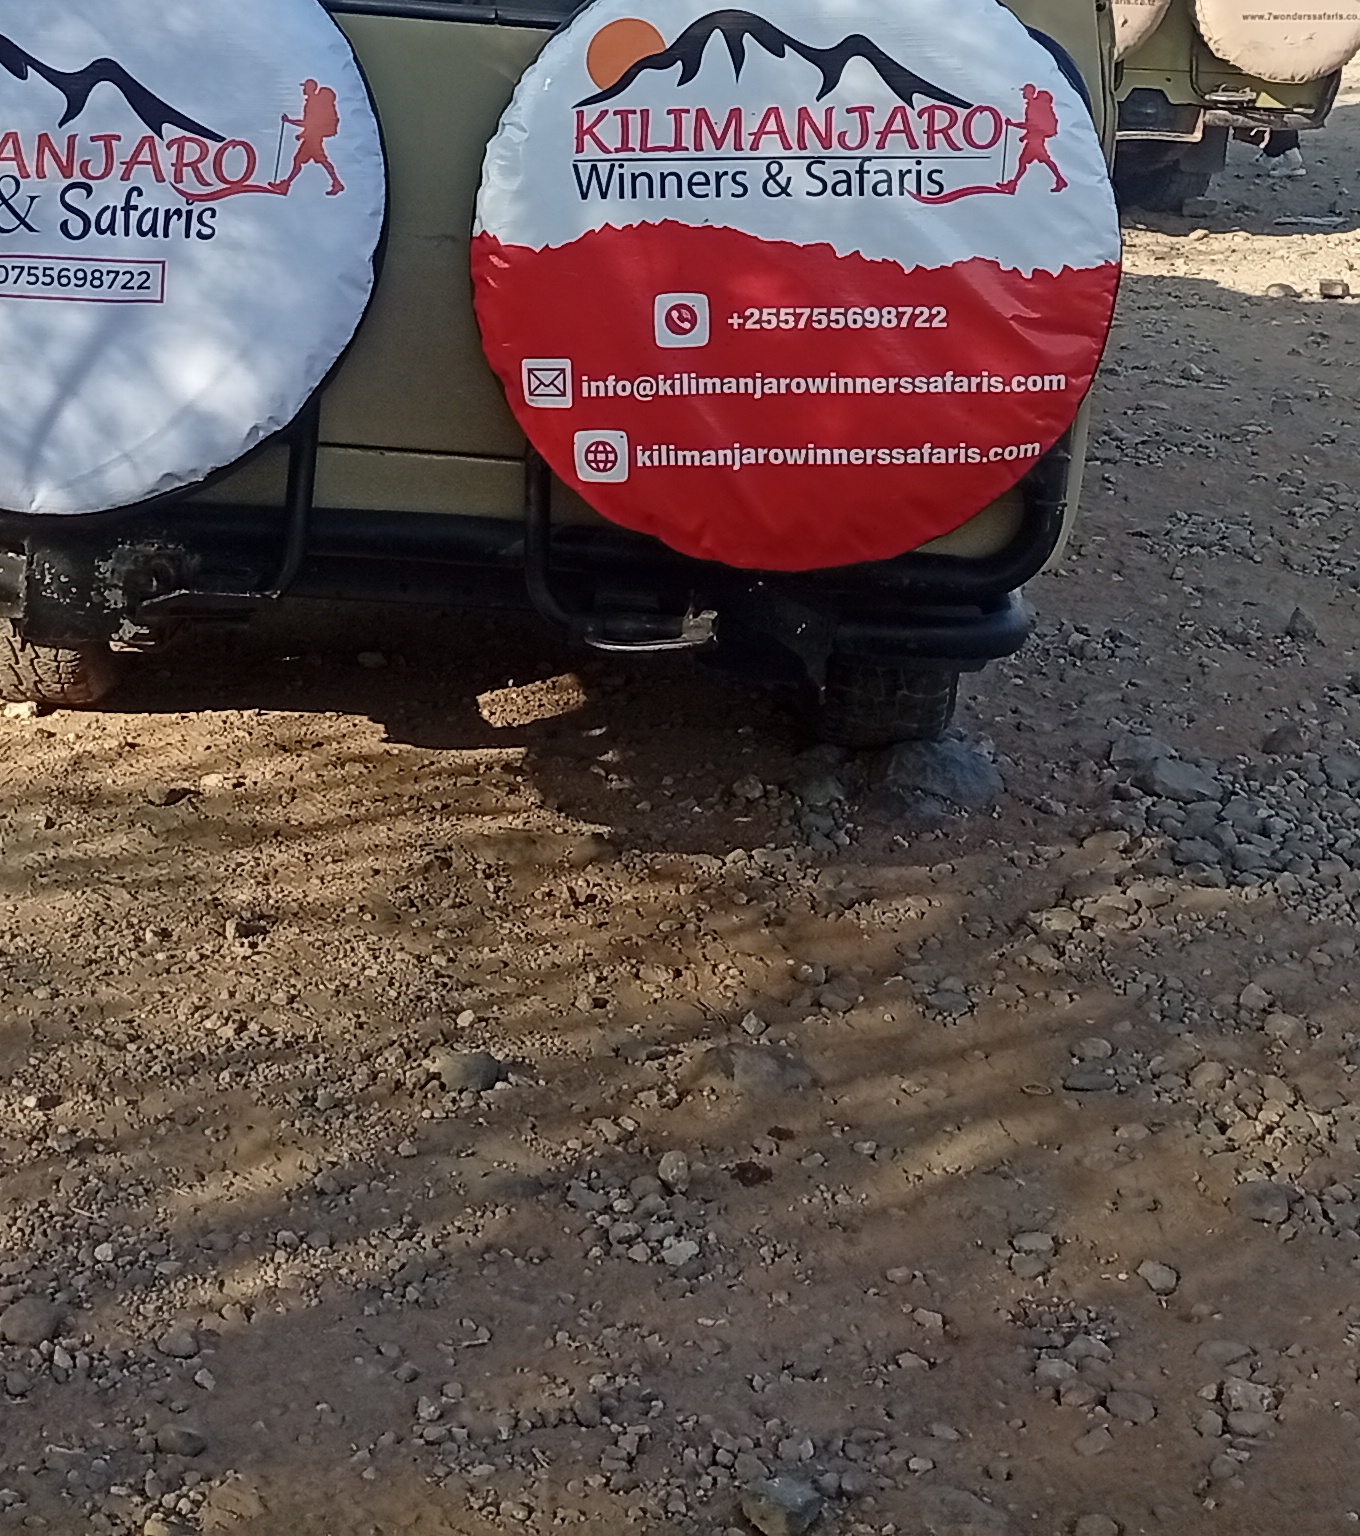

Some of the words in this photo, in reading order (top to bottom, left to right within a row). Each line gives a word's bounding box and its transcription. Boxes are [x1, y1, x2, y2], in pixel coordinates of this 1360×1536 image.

[573, 104, 1004, 154] KILIMANJARO
[572, 163, 749, 200] Winners
[761, 160, 794, 198] &
[805, 159, 945, 198] Safaris
[58, 181, 218, 243] Safaris
[727, 306, 948, 331] +255755698722
[581, 370, 1066, 401] info@kilimanjarowinnerssafaris.com
[636, 440, 1040, 471] kilimanjarowinnerssafaris.com
